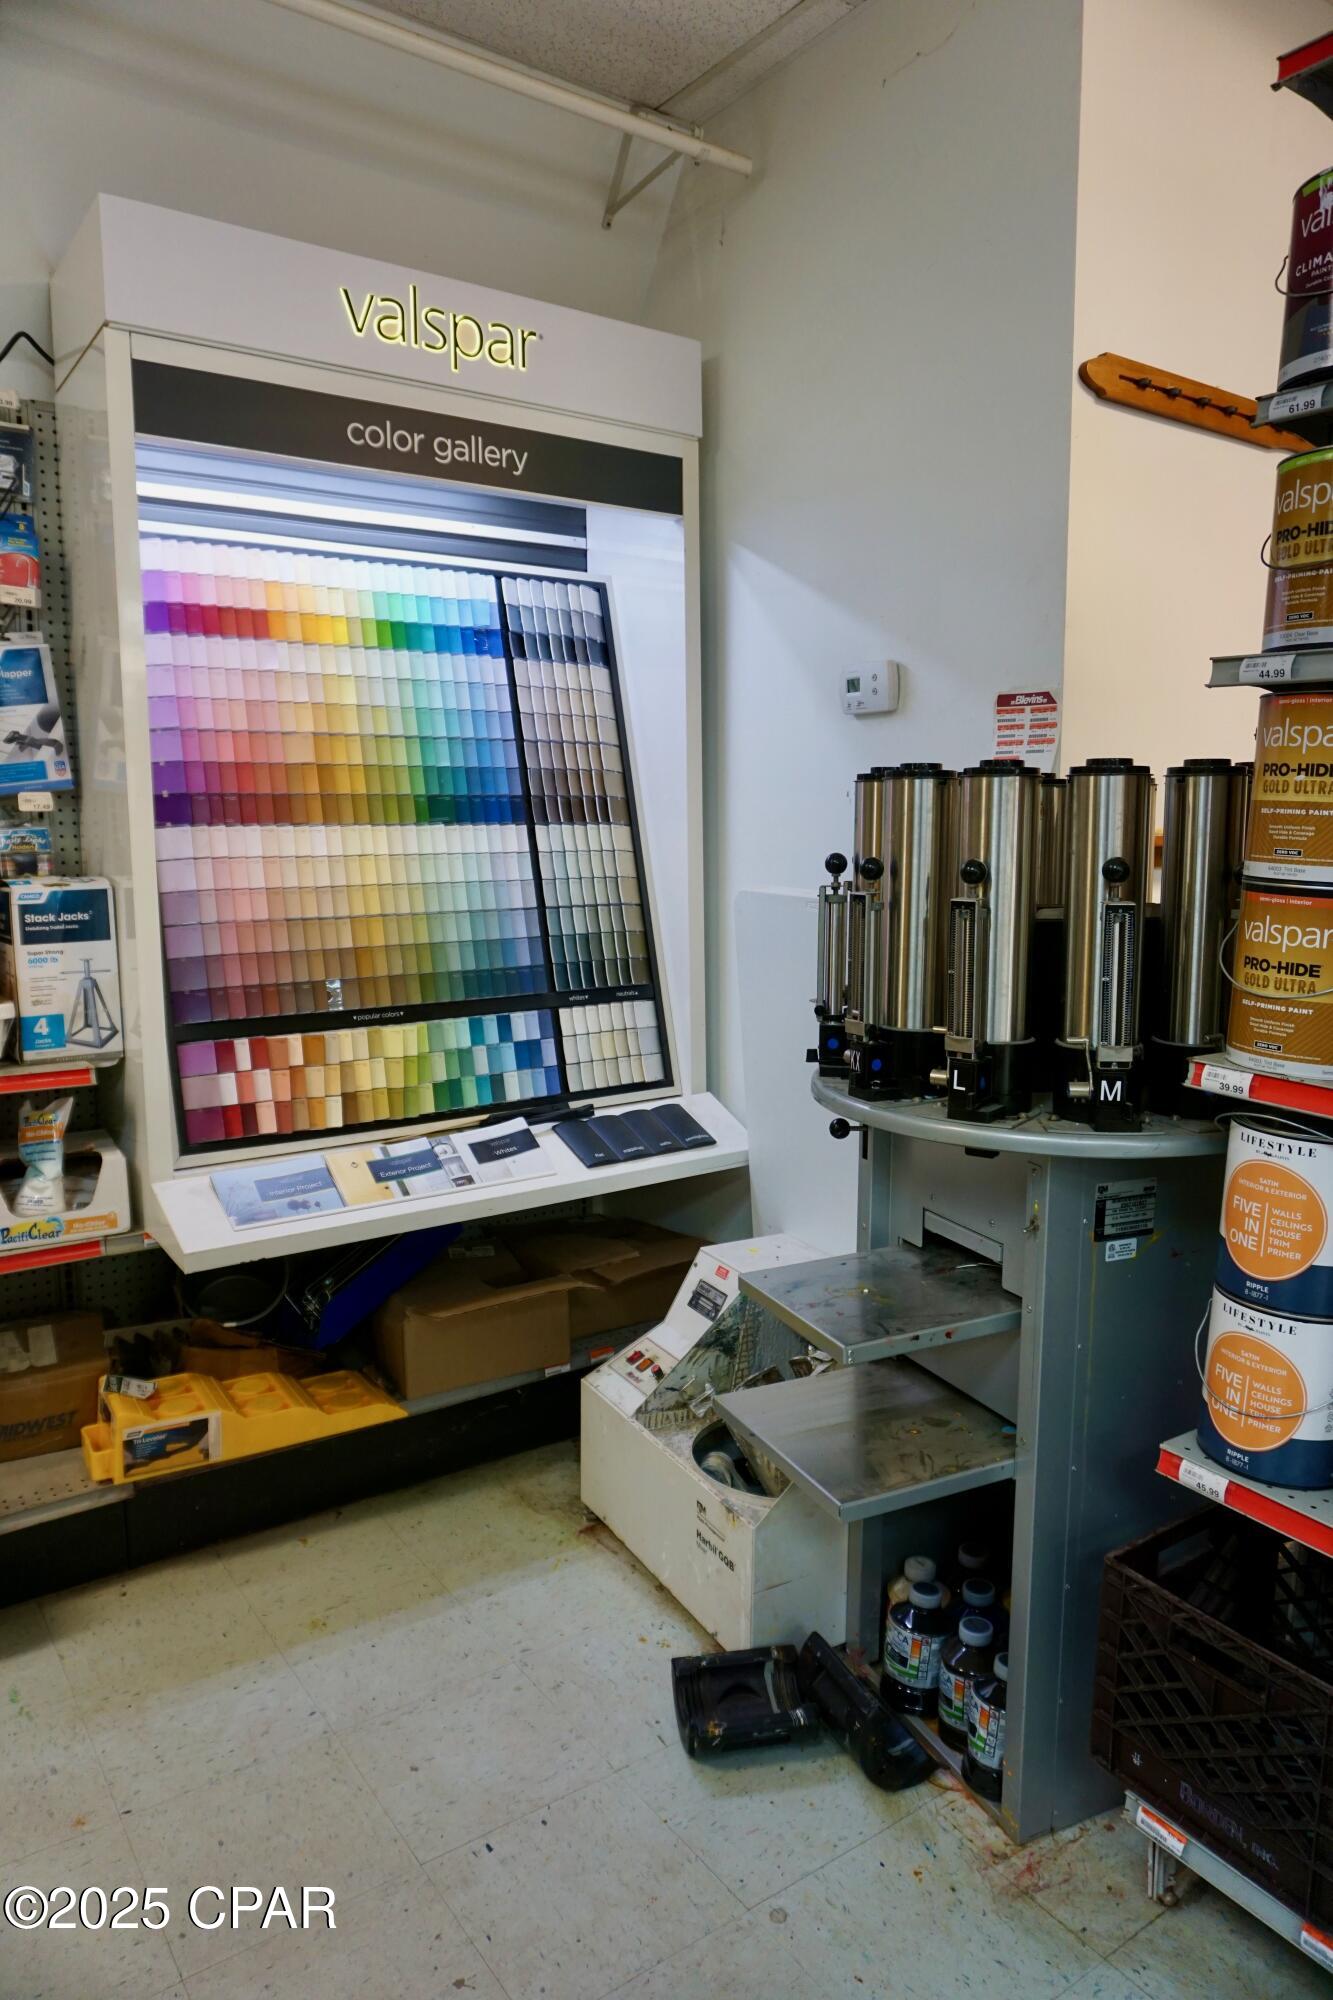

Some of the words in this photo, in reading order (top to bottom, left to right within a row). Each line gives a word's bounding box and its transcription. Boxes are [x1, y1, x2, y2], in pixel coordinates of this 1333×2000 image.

[1301, 206, 1333, 239] val
[339, 284, 536, 372] valspar
[1289, 400, 1315, 414] 61.99
[346, 418, 425, 456] color
[433, 432, 528, 475] gallery
[1259, 669, 1285, 680] 44.99
[1015, 694, 1043, 705] Blevins
[1263, 780, 1289, 794] GOLD
[1261, 807, 1306, 815] SELF-PRIMING
[24, 913, 55, 924] Stack
[58, 912, 89, 922] Jacks
[1243, 915, 1333, 953] valspar
[1243, 956, 1321, 979] PRO-HIDE
[1244, 971, 1269, 989] GOLD
[1274, 977, 1317, 994] ULTRA
[382, 1011, 400, 1019] colors
[1242, 1000, 1286, 1012] SELF-PRIMING
[1288, 1007, 1314, 1015] PAINT
[33, 1018, 48, 1036] 4
[953, 1070, 966, 1092] L
[1219, 1081, 1244, 1095] 39.99
[1100, 1081, 1121, 1102] M
[1241, 1132, 1317, 1159] LIFESTYLE
[379, 1166, 406, 1178] Exterior
[407, 1162, 433, 1173] Project
[296, 1181, 323, 1192] Project
[1239, 1178, 1264, 1193] INTERIOR
[1271, 1188, 1307, 1201] EXTERIOR
[1259, 1177, 1279, 1188] SATIN
[1233, 1195, 1262, 1218] FIVE
[1272, 1208, 1302, 1221] WALLS
[1245, 1218, 1260, 1236] IN
[1270, 1218, 1313, 1233] CEILINGS
[1, 1223, 62, 1245] PacifiClear
[1230, 1230, 1258, 1251] ONE
[1269, 1228, 1301, 1241] HOUSE
[1269, 1238, 1290, 1249] TRIM
[1267, 1248, 1302, 1261] PRIMER
[1246, 1280, 1269, 1294] RIPPLE
[1223, 1302, 1298, 1337] LIFESTYLE
[1241, 1350, 1260, 1361] SATIN
[1246, 1358, 1251, 1366] &
[1251, 1360, 1287, 1377] EXTERIOR
[1215, 1363, 1242, 1389] FIVE
[1226, 1387, 1241, 1405] IN
[1252, 1381, 1282, 1396] WALLS
[1249, 1400, 1281, 1415] HOUSE
[1251, 1391, 1293, 1409] CEILINGS
[1247, 1418, 1282, 1435] PRIMER
[1227, 1448, 1249, 1463] RIPPLE
[1195, 1481, 1220, 1499] 45.99
